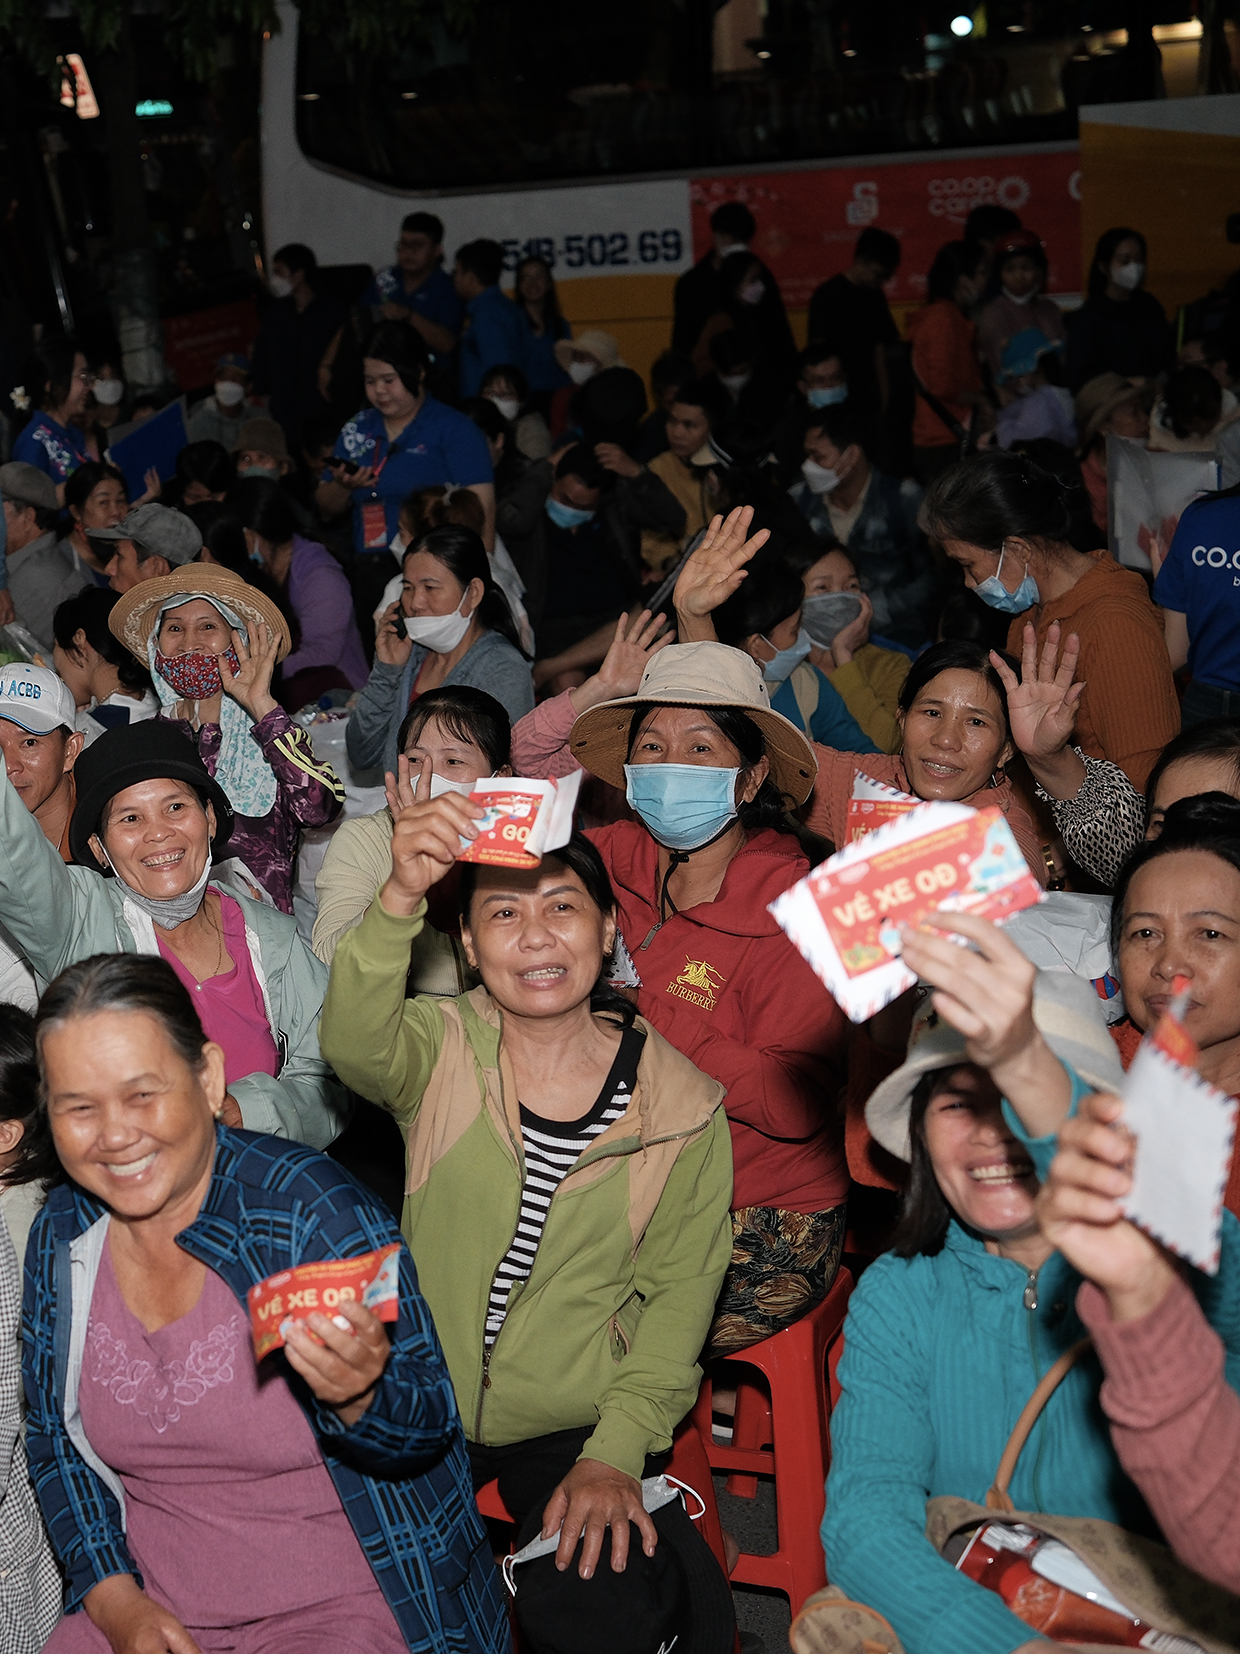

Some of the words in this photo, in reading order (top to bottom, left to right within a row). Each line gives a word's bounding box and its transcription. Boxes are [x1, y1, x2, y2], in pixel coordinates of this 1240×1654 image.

[832, 891, 876, 927] VÉ
[872, 877, 916, 911] XE
[665, 981, 717, 1011] BURBERRY
[257, 1293, 284, 1321] VÉ
[287, 1288, 319, 1310] XE
